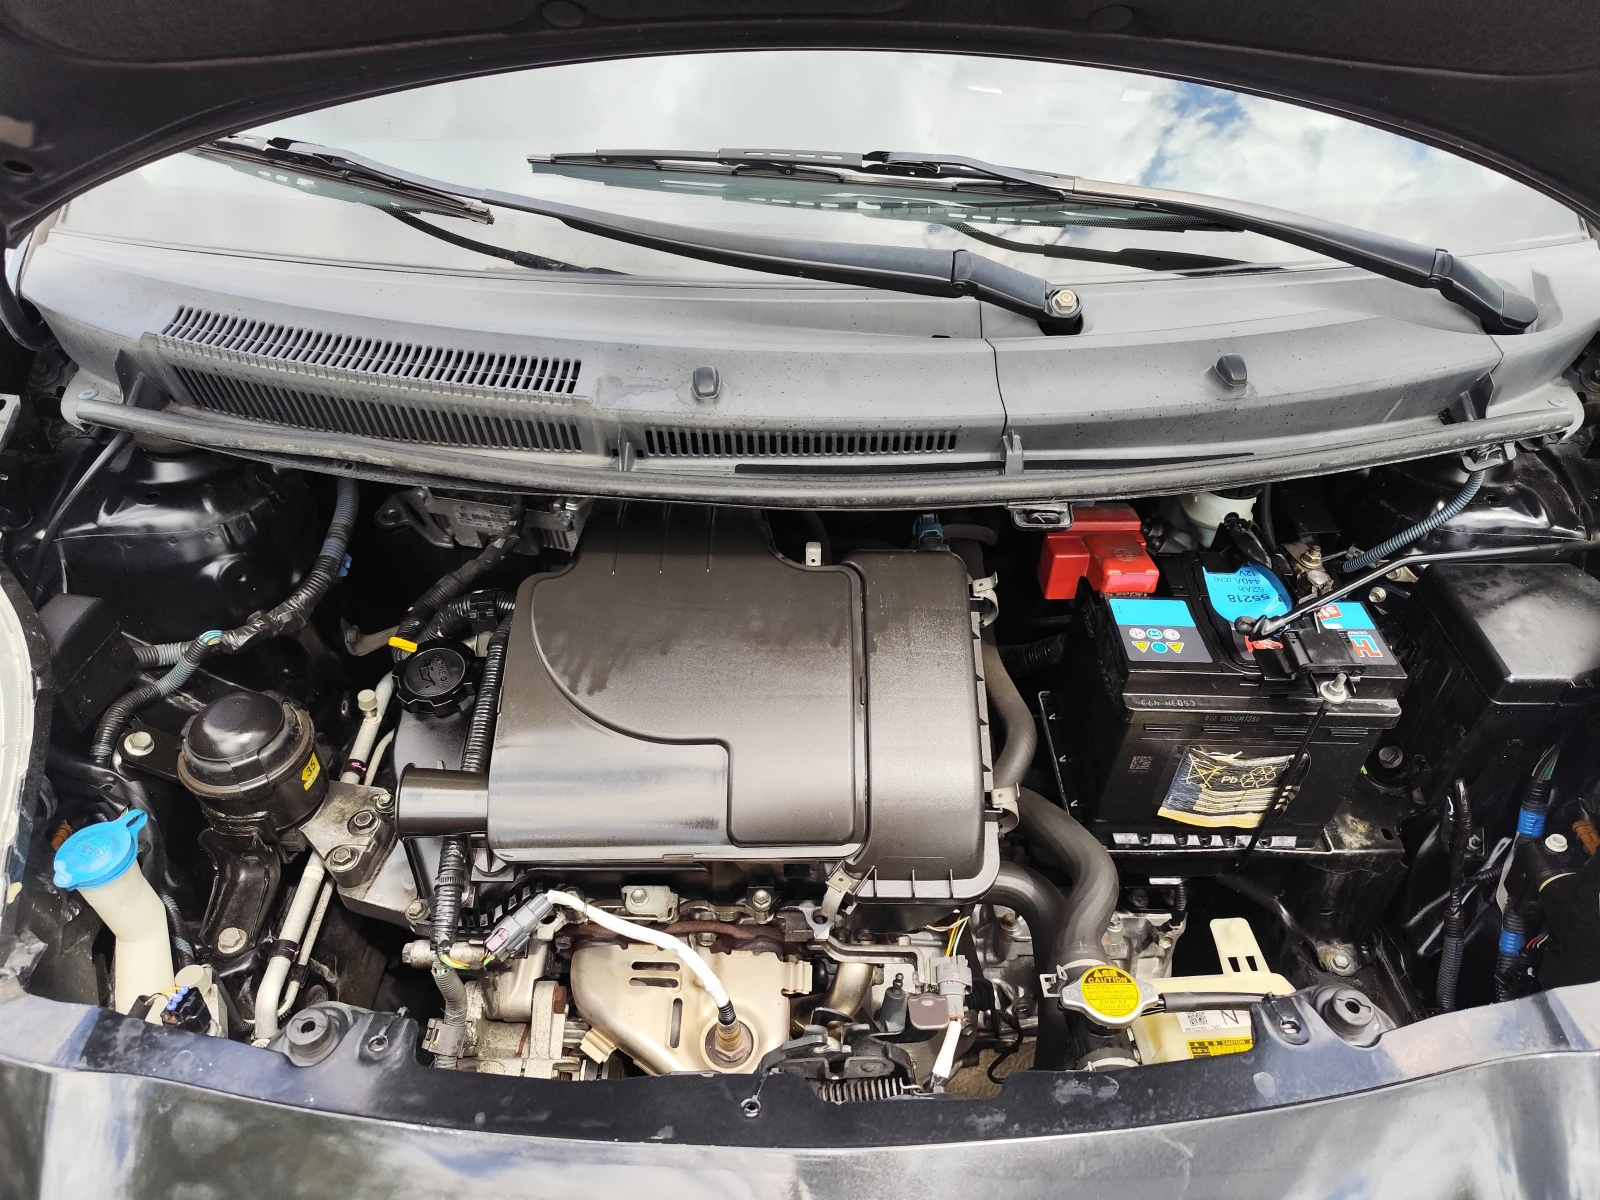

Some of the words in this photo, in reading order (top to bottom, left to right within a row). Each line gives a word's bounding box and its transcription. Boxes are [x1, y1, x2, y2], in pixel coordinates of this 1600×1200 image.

[1234, 577, 1261, 585] 440A
[1227, 593, 1270, 603] 55218
[434, 652, 446, 676] ENGINE
[440, 676, 448, 688] OIL
[306, 759, 316, 777] 35
[1220, 776, 1238, 785] Pb
